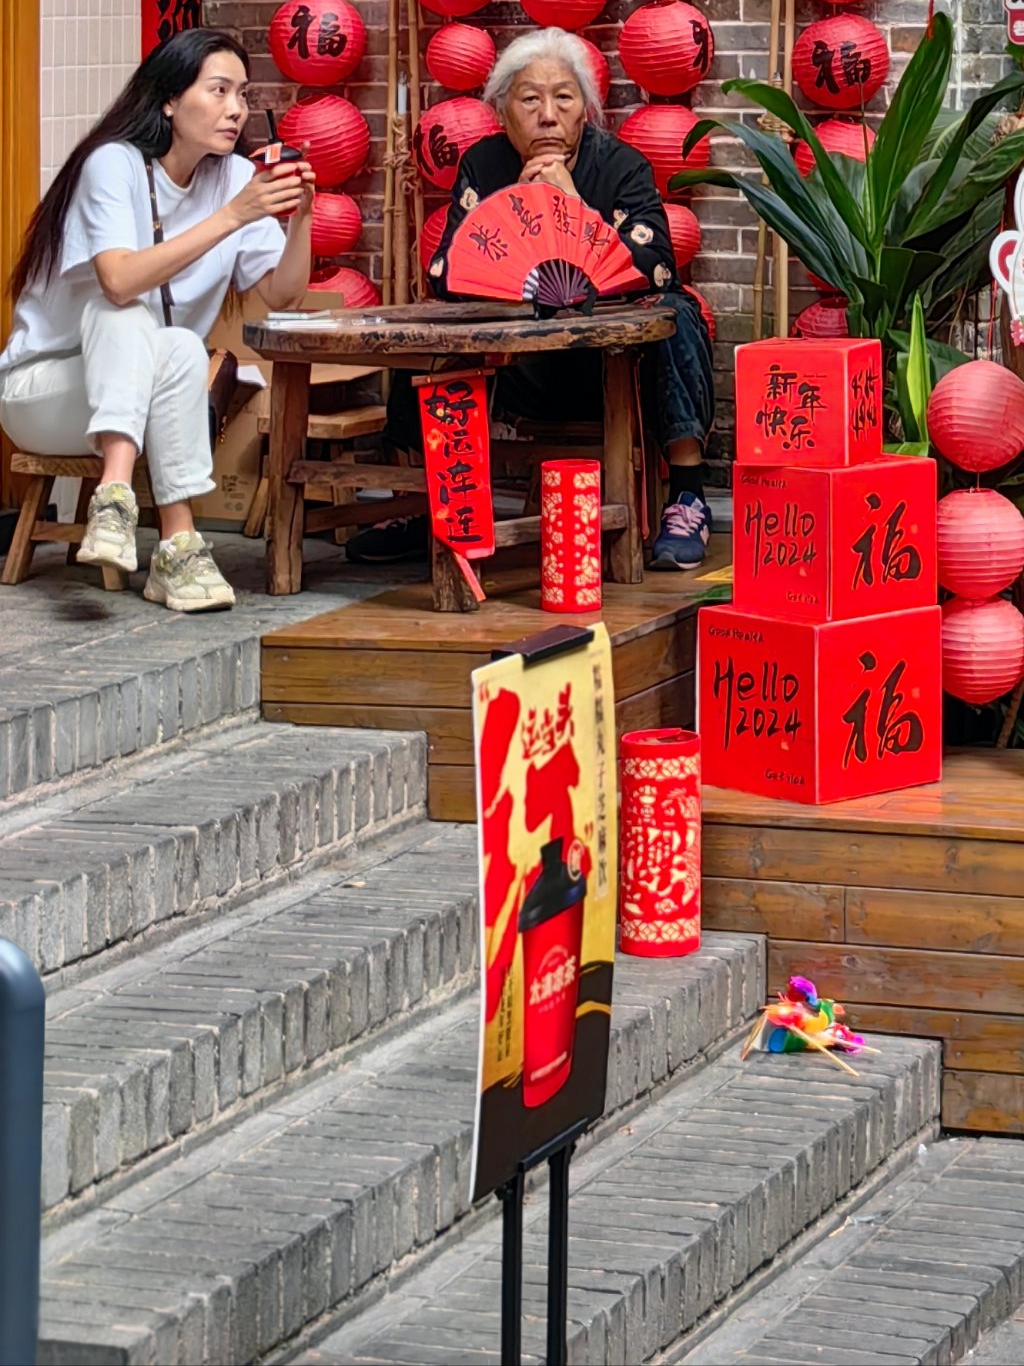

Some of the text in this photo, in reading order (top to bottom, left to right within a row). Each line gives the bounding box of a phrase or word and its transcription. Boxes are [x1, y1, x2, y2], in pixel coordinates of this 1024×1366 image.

[286, 5, 348, 60] 福
[812, 40, 871, 94] 福
[417, 124, 459, 176] 福
[424, 380, 483, 543] 好运连连
[744, 498, 816, 578] Hello
[763, 541, 817, 570] 2024
[851, 492, 922, 590] 福
[713, 656, 799, 751] Hello
[736, 707, 803, 741] 2024
[842, 650, 923, 770] 福
